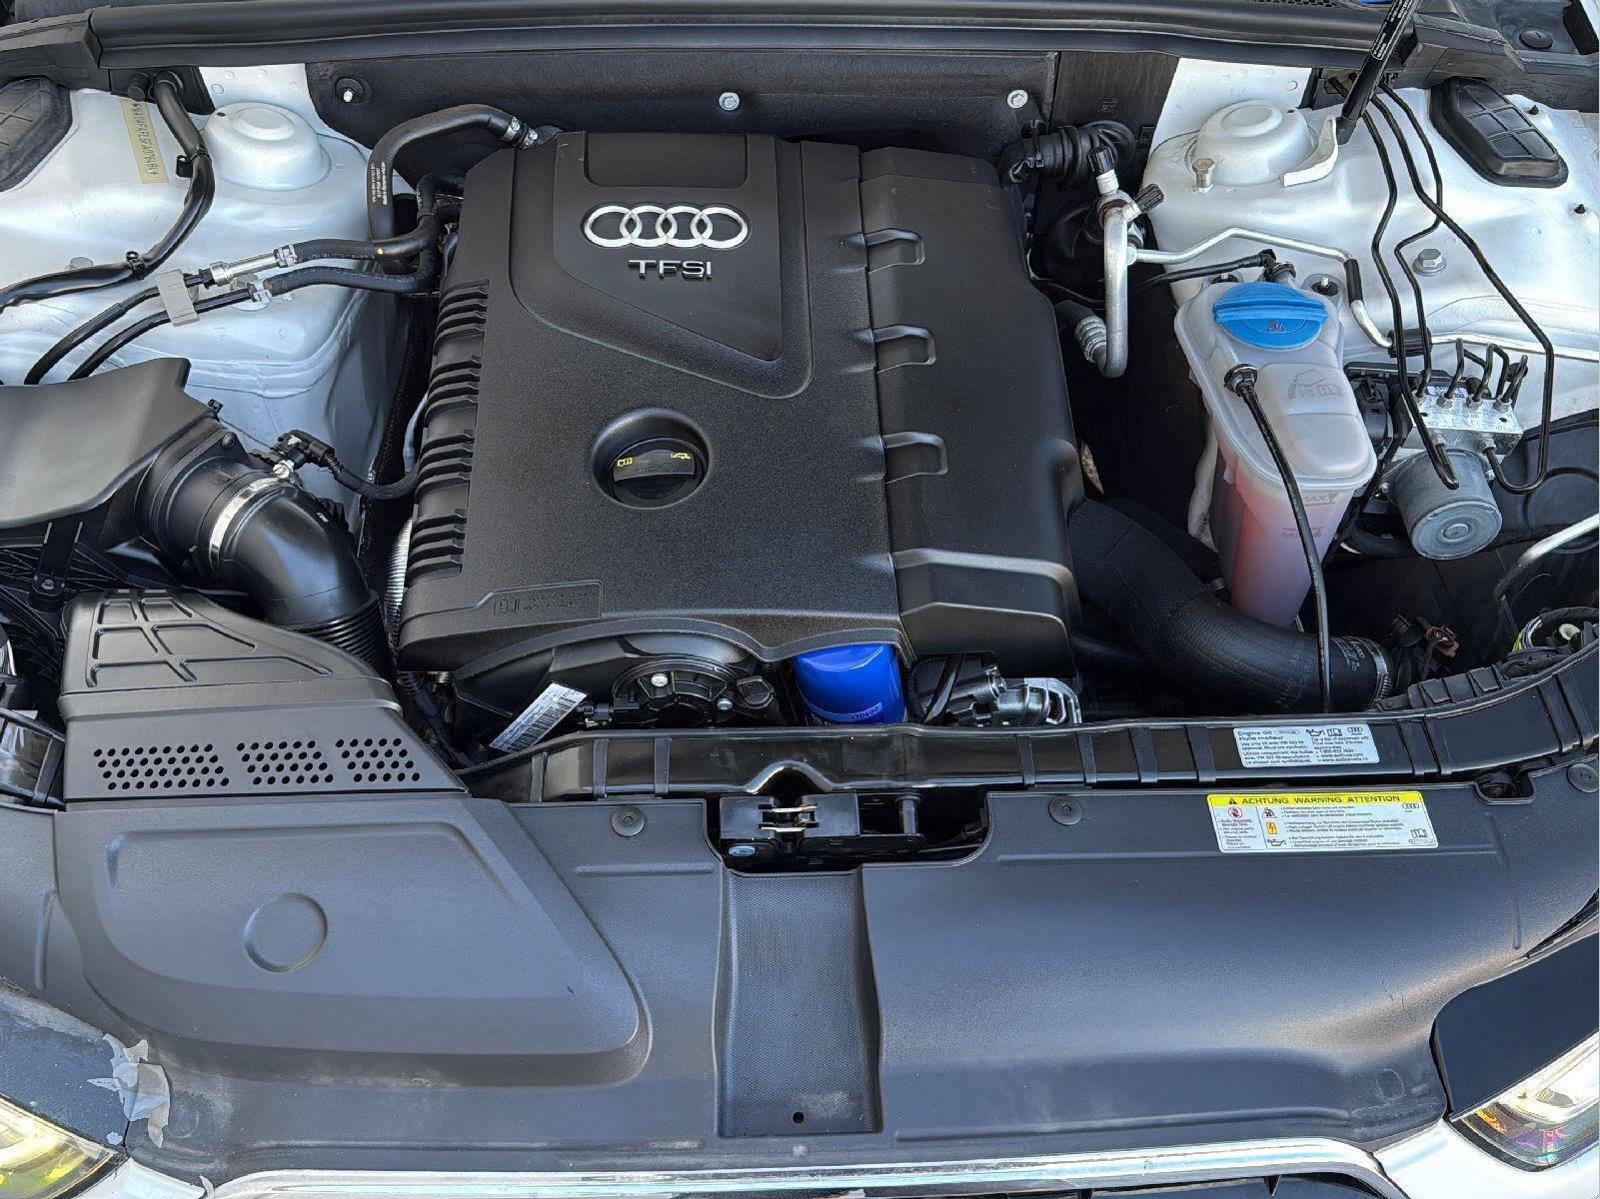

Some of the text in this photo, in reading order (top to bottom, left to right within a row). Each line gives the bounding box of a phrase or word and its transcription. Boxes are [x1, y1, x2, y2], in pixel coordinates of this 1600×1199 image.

[628, 258, 713, 281] TFSI
[1242, 794, 1400, 805] ACHTUNG WARNING ATTENTION
